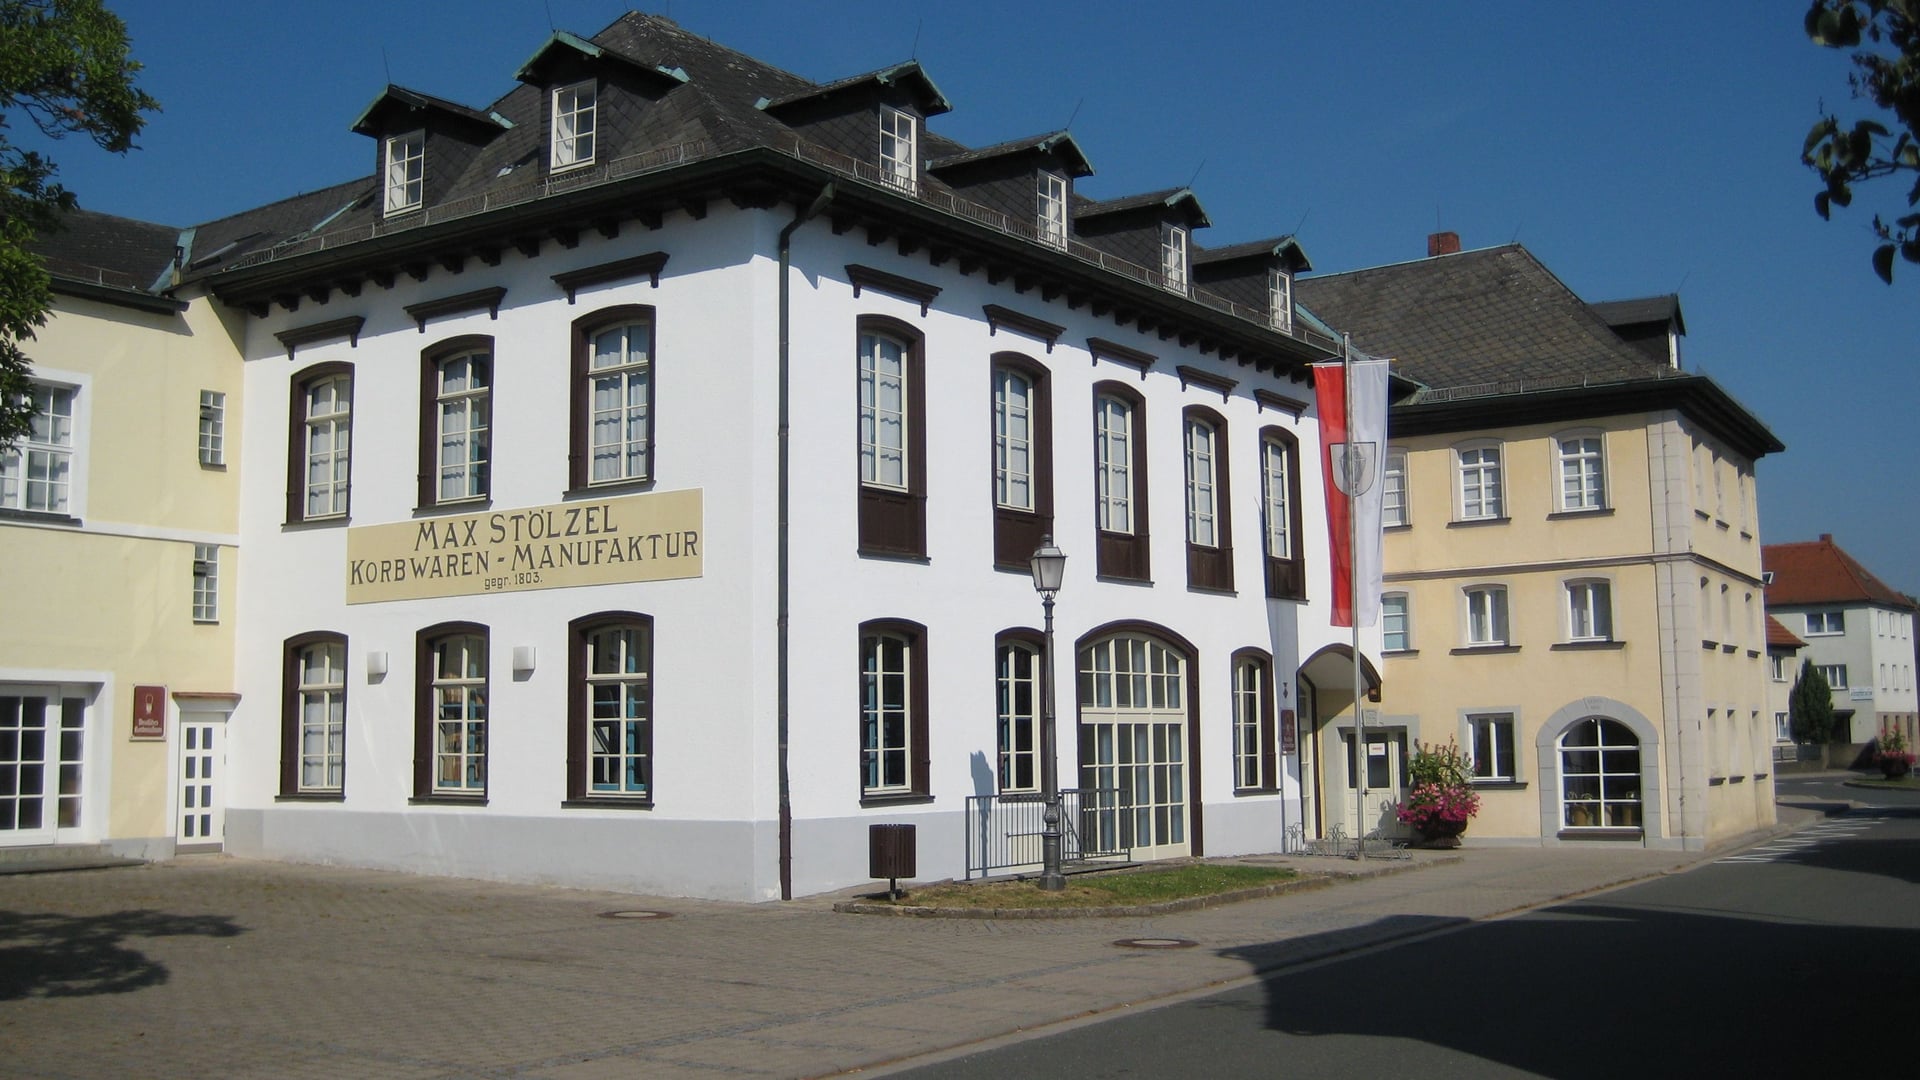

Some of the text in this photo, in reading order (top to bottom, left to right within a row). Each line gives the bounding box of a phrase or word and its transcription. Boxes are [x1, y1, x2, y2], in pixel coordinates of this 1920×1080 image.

[414, 504, 618, 552] MAX STÖLZEL
[484, 571, 543, 590] gegr. 1803.
